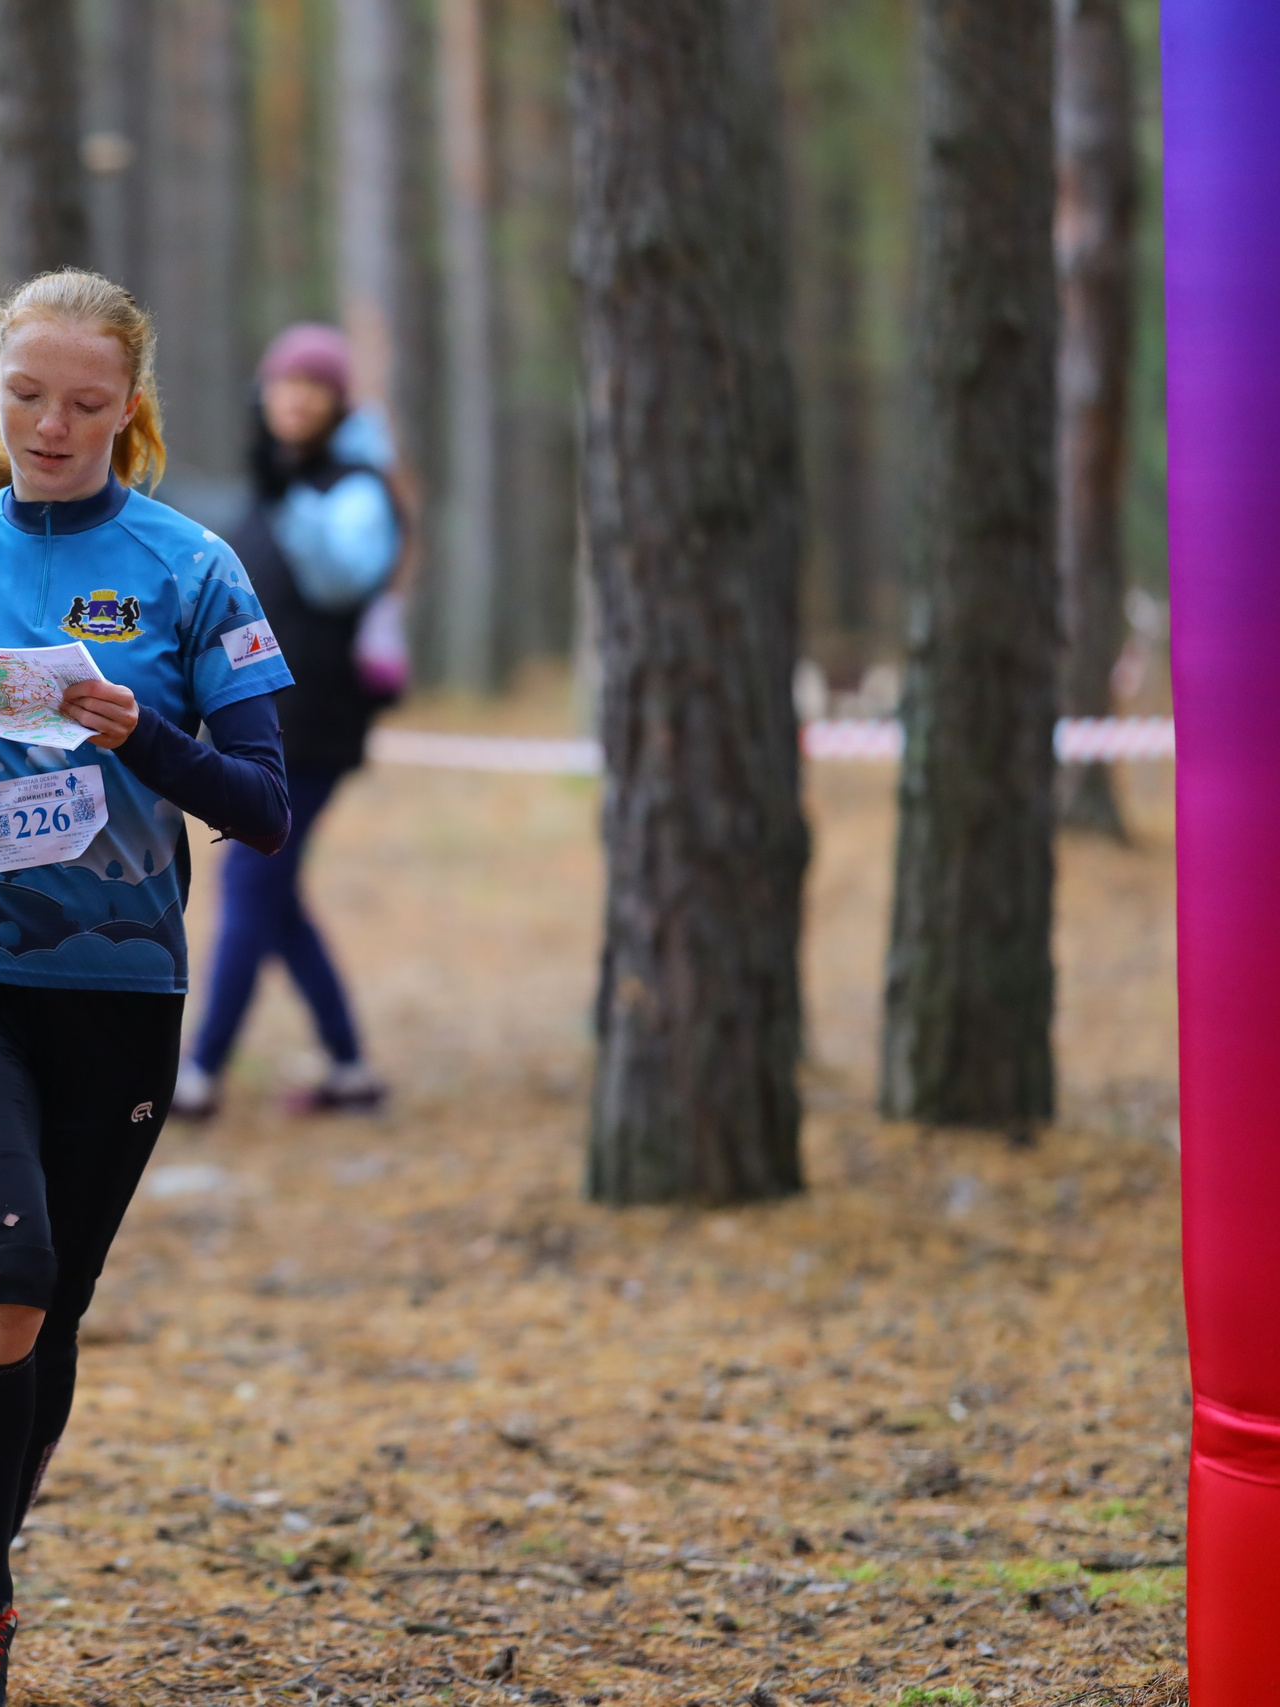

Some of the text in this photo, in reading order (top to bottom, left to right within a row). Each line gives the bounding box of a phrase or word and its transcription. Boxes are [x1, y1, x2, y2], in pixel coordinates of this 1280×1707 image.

[13, 775, 59, 787] ЗОЛОТАЯ ОСЕНЬ
[17, 792, 53, 803] ДОМИНТЕР
[13, 802, 71, 840] 226
